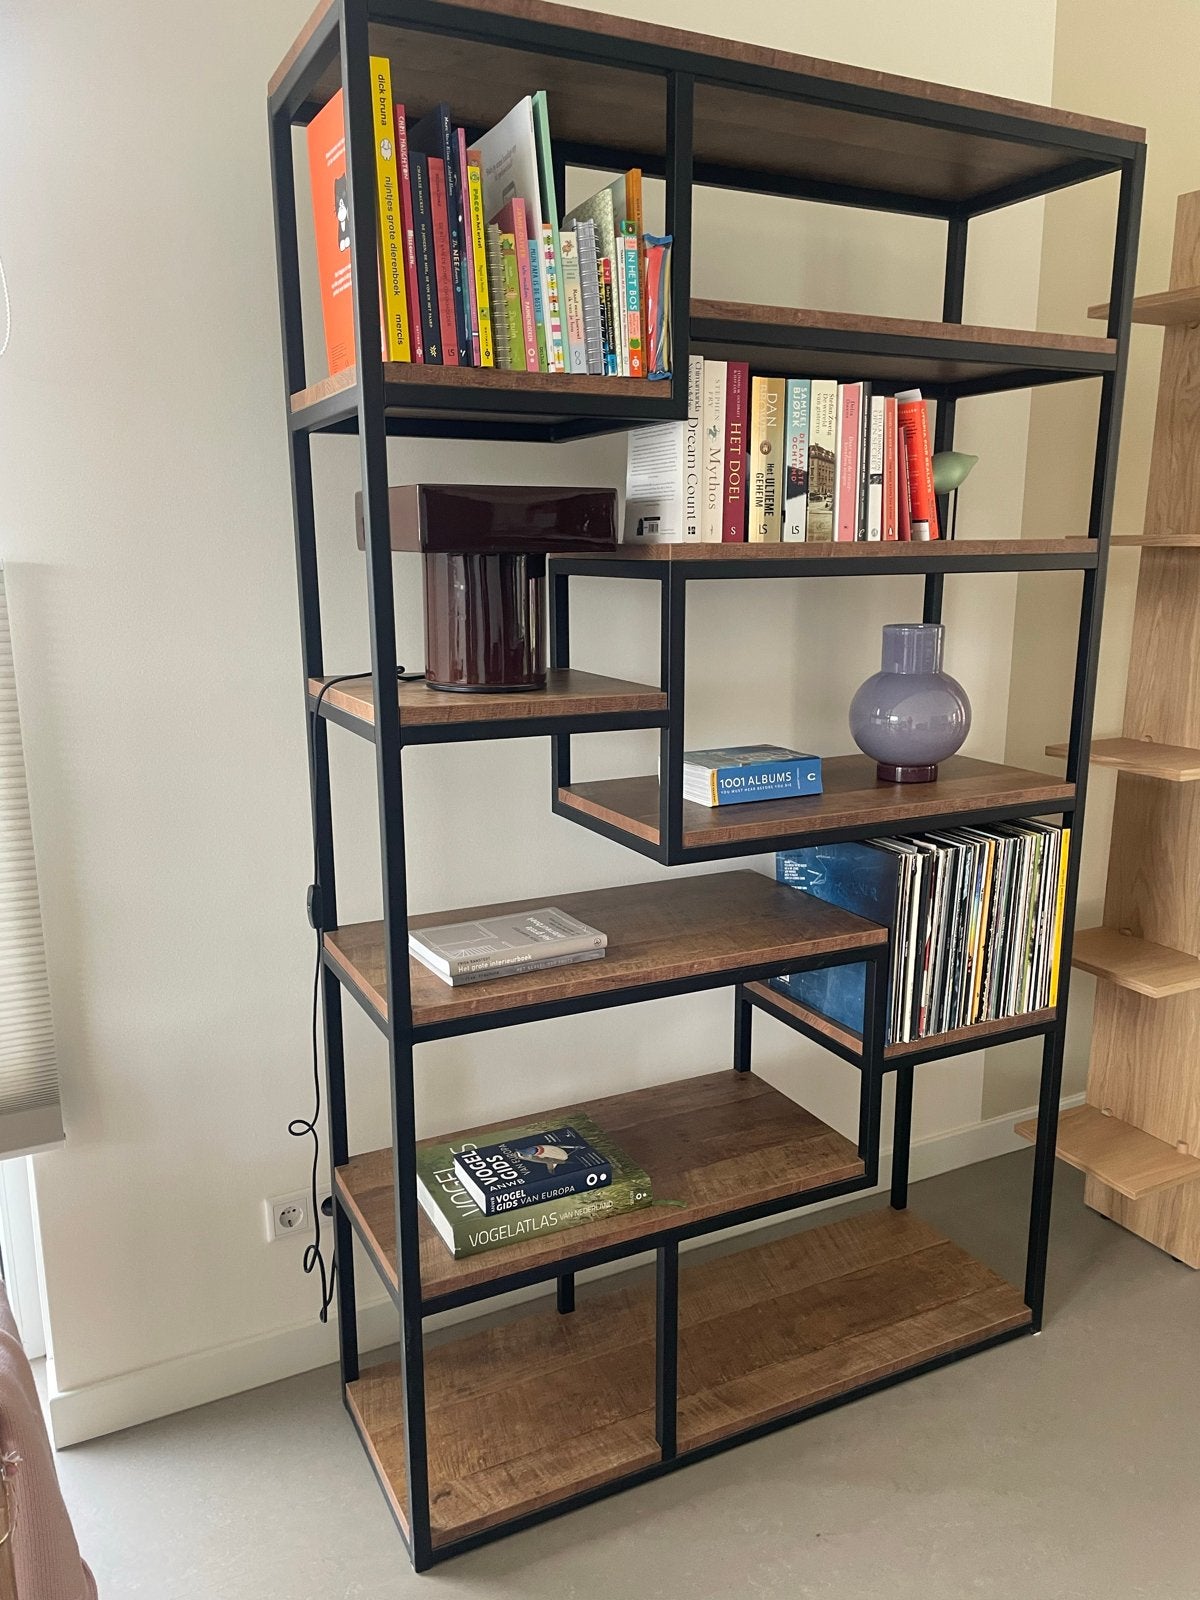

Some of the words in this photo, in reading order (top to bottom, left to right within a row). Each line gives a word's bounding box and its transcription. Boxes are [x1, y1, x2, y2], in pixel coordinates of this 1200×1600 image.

[378, 74, 386, 94] dick
[379, 96, 387, 126] bruna
[400, 138, 408, 180] HAUGHTON
[384, 176, 393, 212] nijntjes
[471, 187, 481, 212] PACO
[386, 214, 396, 240] grote
[390, 242, 400, 296] dierenboek
[626, 251, 635, 262] IN
[627, 264, 637, 286] HET
[628, 289, 637, 310] BOS
[395, 314, 404, 345] mercis
[766, 393, 778, 428] DAN
[792, 387, 800, 429] BJØRK
[799, 388, 807, 430] SAMUEL
[822, 393, 828, 403] De
[730, 422, 742, 455] HET
[799, 433, 804, 444] DE
[826, 416, 834, 436] Zweig
[688, 417, 699, 470] Dream
[706, 448, 722, 510] Mythos
[728, 460, 741, 503] DOEL
[766, 464, 774, 476] Het
[686, 473, 699, 520] Count
[755, 472, 764, 508] GEHEIM
[764, 477, 775, 517] ULTIEME
[730, 526, 736, 536] S
[720, 778, 745, 788] 1001
[748, 772, 791, 785] ALBUMS
[458, 965, 470, 973] Het
[471, 961, 488, 971] grote
[489, 954, 532, 967] interieurboek
[462, 1150, 498, 1186] VOGEL
[486, 1154, 518, 1180] GIDS
[490, 1178, 526, 1192] ANWB
[496, 1190, 526, 1203] VOGEL
[496, 1199, 518, 1211] GIDS
[520, 1194, 539, 1204] VAN
[542, 1186, 576, 1200] EUROPA
[468, 1212, 558, 1248] VOGELATLAS
[559, 1210, 574, 1221] VAN
[574, 1200, 614, 1218] NEDERLAND
